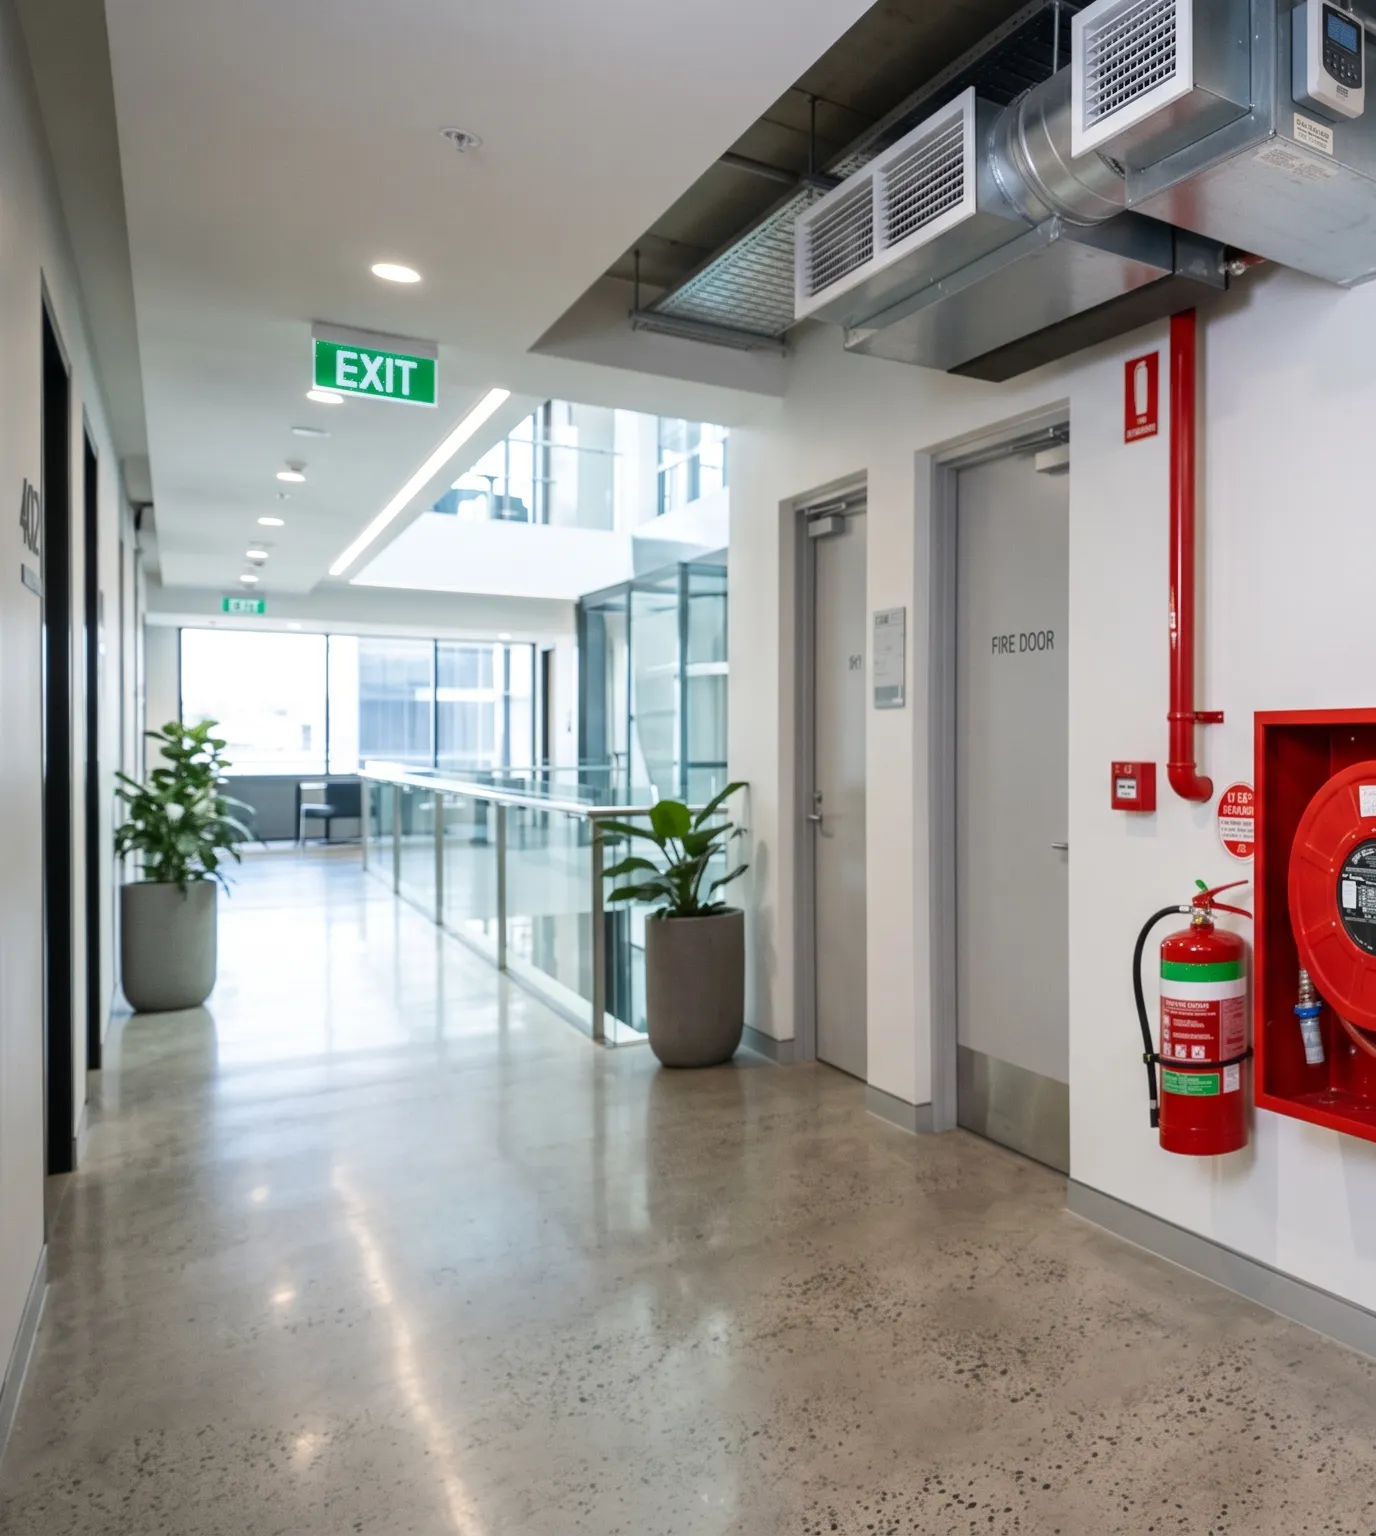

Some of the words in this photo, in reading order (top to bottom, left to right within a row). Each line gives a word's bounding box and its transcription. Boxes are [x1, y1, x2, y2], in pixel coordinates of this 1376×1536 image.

[336, 350, 418, 396] EXIT
[20, 477, 39, 556] 402
[992, 634, 1015, 655] FIRE
[1020, 630, 1054, 652] DOOR
